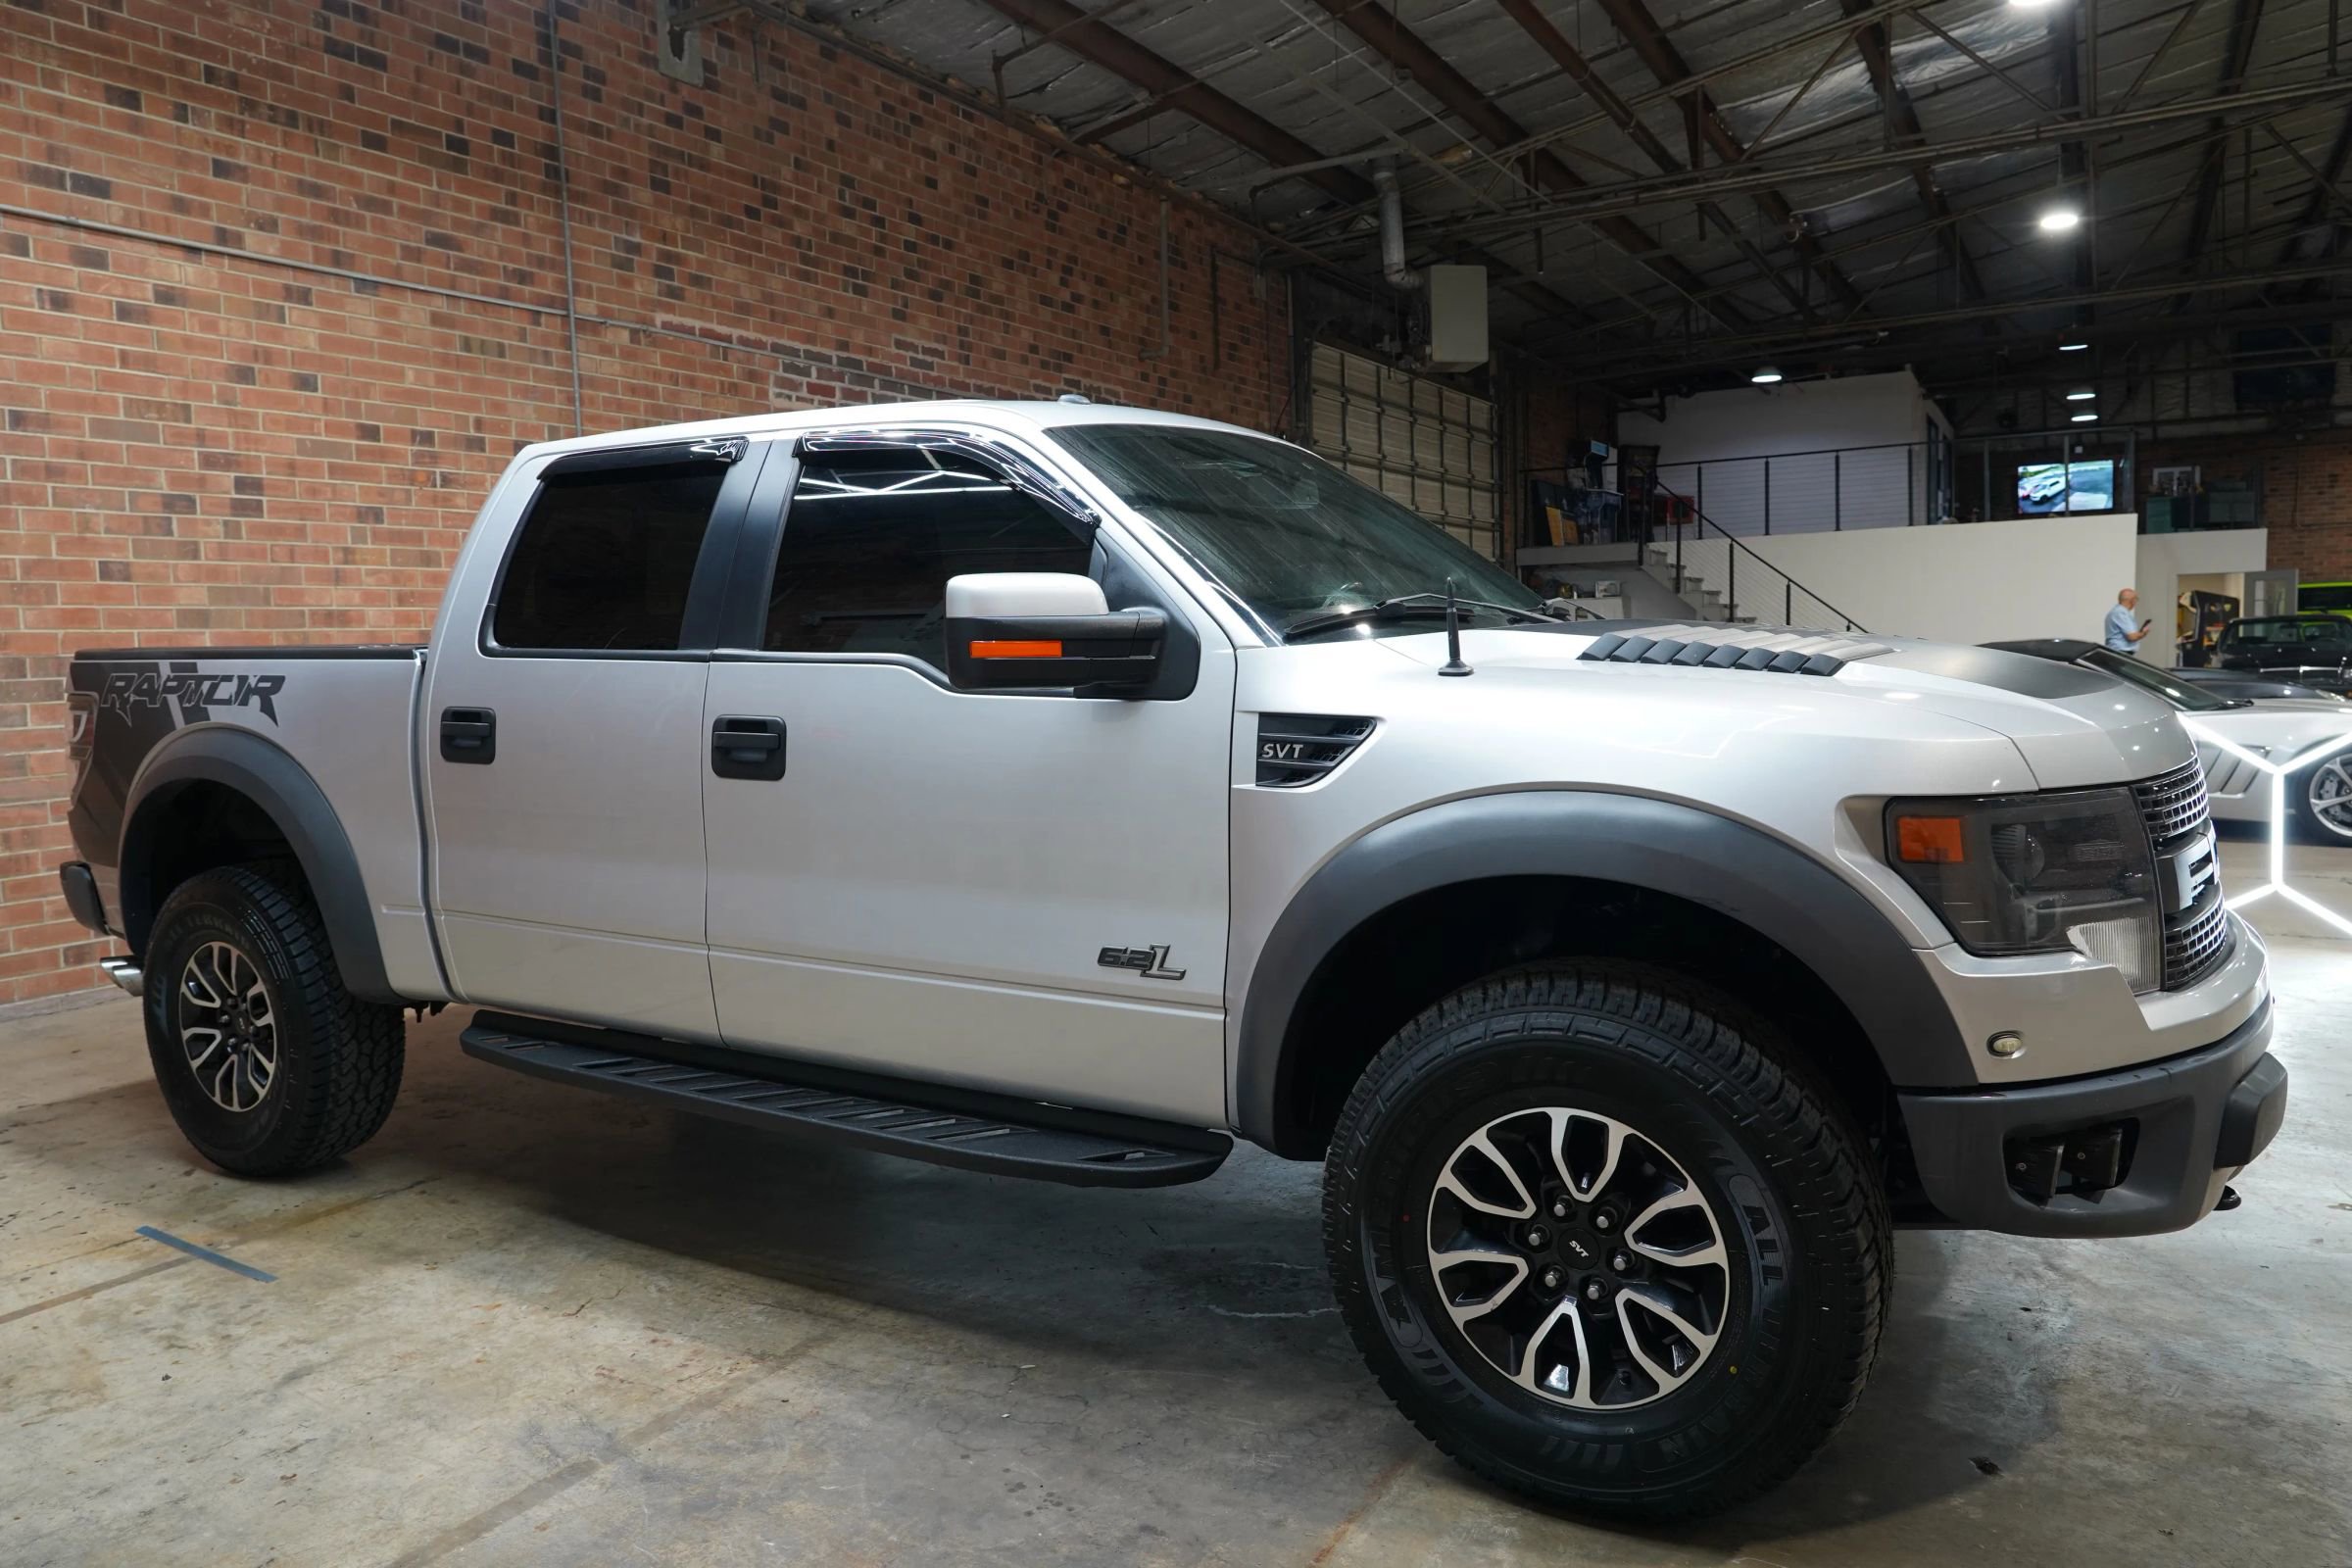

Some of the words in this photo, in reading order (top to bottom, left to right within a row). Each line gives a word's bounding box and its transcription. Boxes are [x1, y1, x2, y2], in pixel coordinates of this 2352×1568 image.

[100, 672, 286, 728] RAPTOR
[1261, 742, 1304, 760] SVT
[1569, 1240, 1589, 1257] SVT
[1742, 1205, 1783, 1286] ALL
